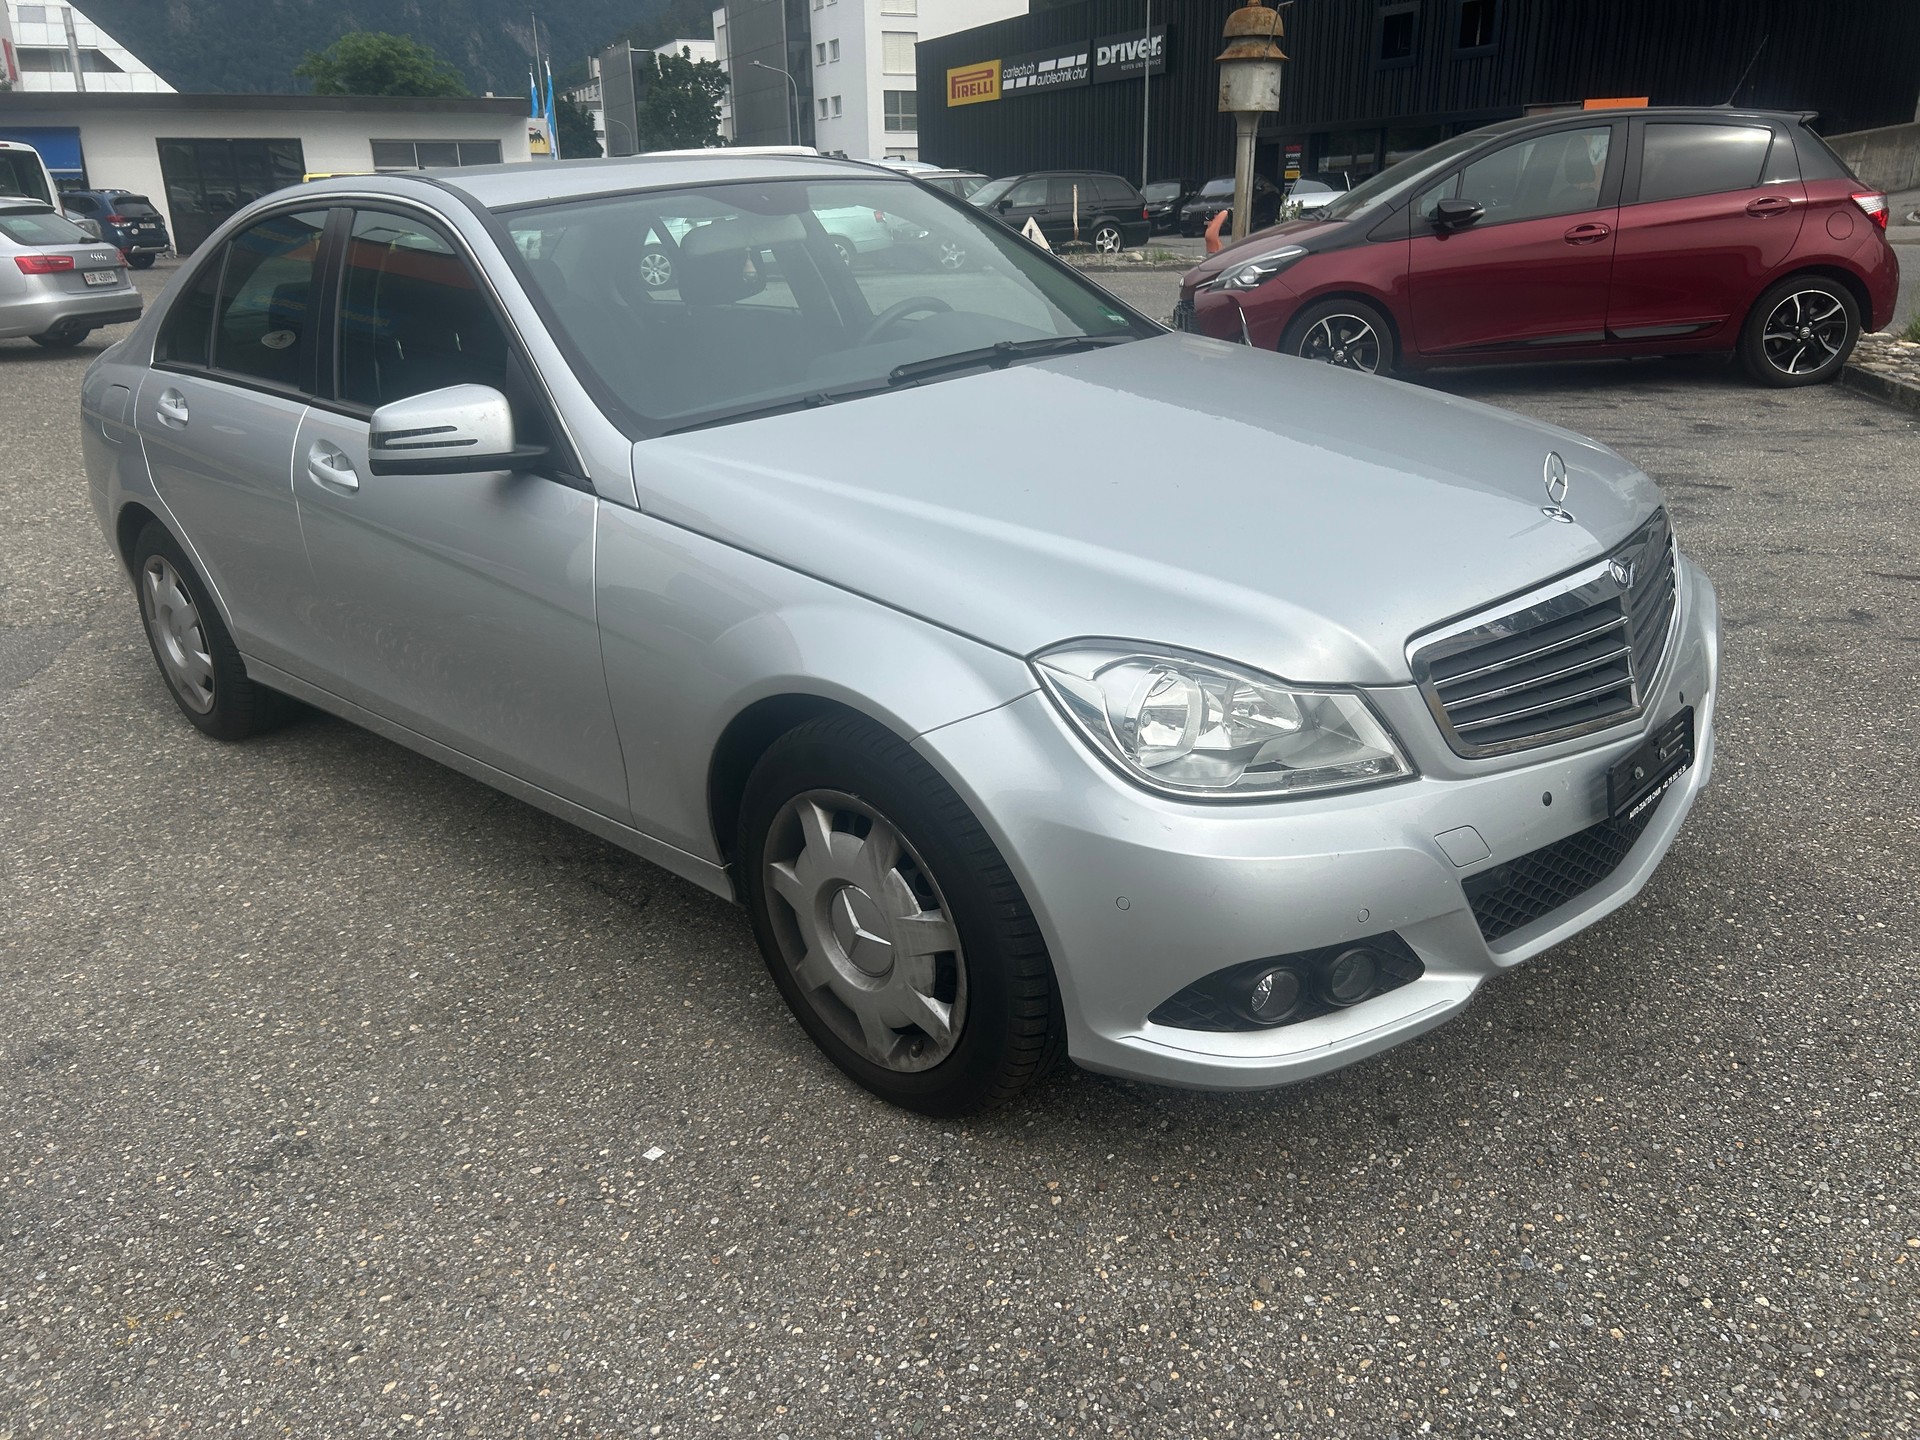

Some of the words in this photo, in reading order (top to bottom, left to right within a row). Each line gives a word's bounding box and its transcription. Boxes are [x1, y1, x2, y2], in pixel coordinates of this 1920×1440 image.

[1002, 62, 1035, 79] cartech.ch
[1036, 71, 1072, 86] autotechnik
[1072, 67, 1088, 81] chur
[951, 68, 994, 99] PIRELLI
